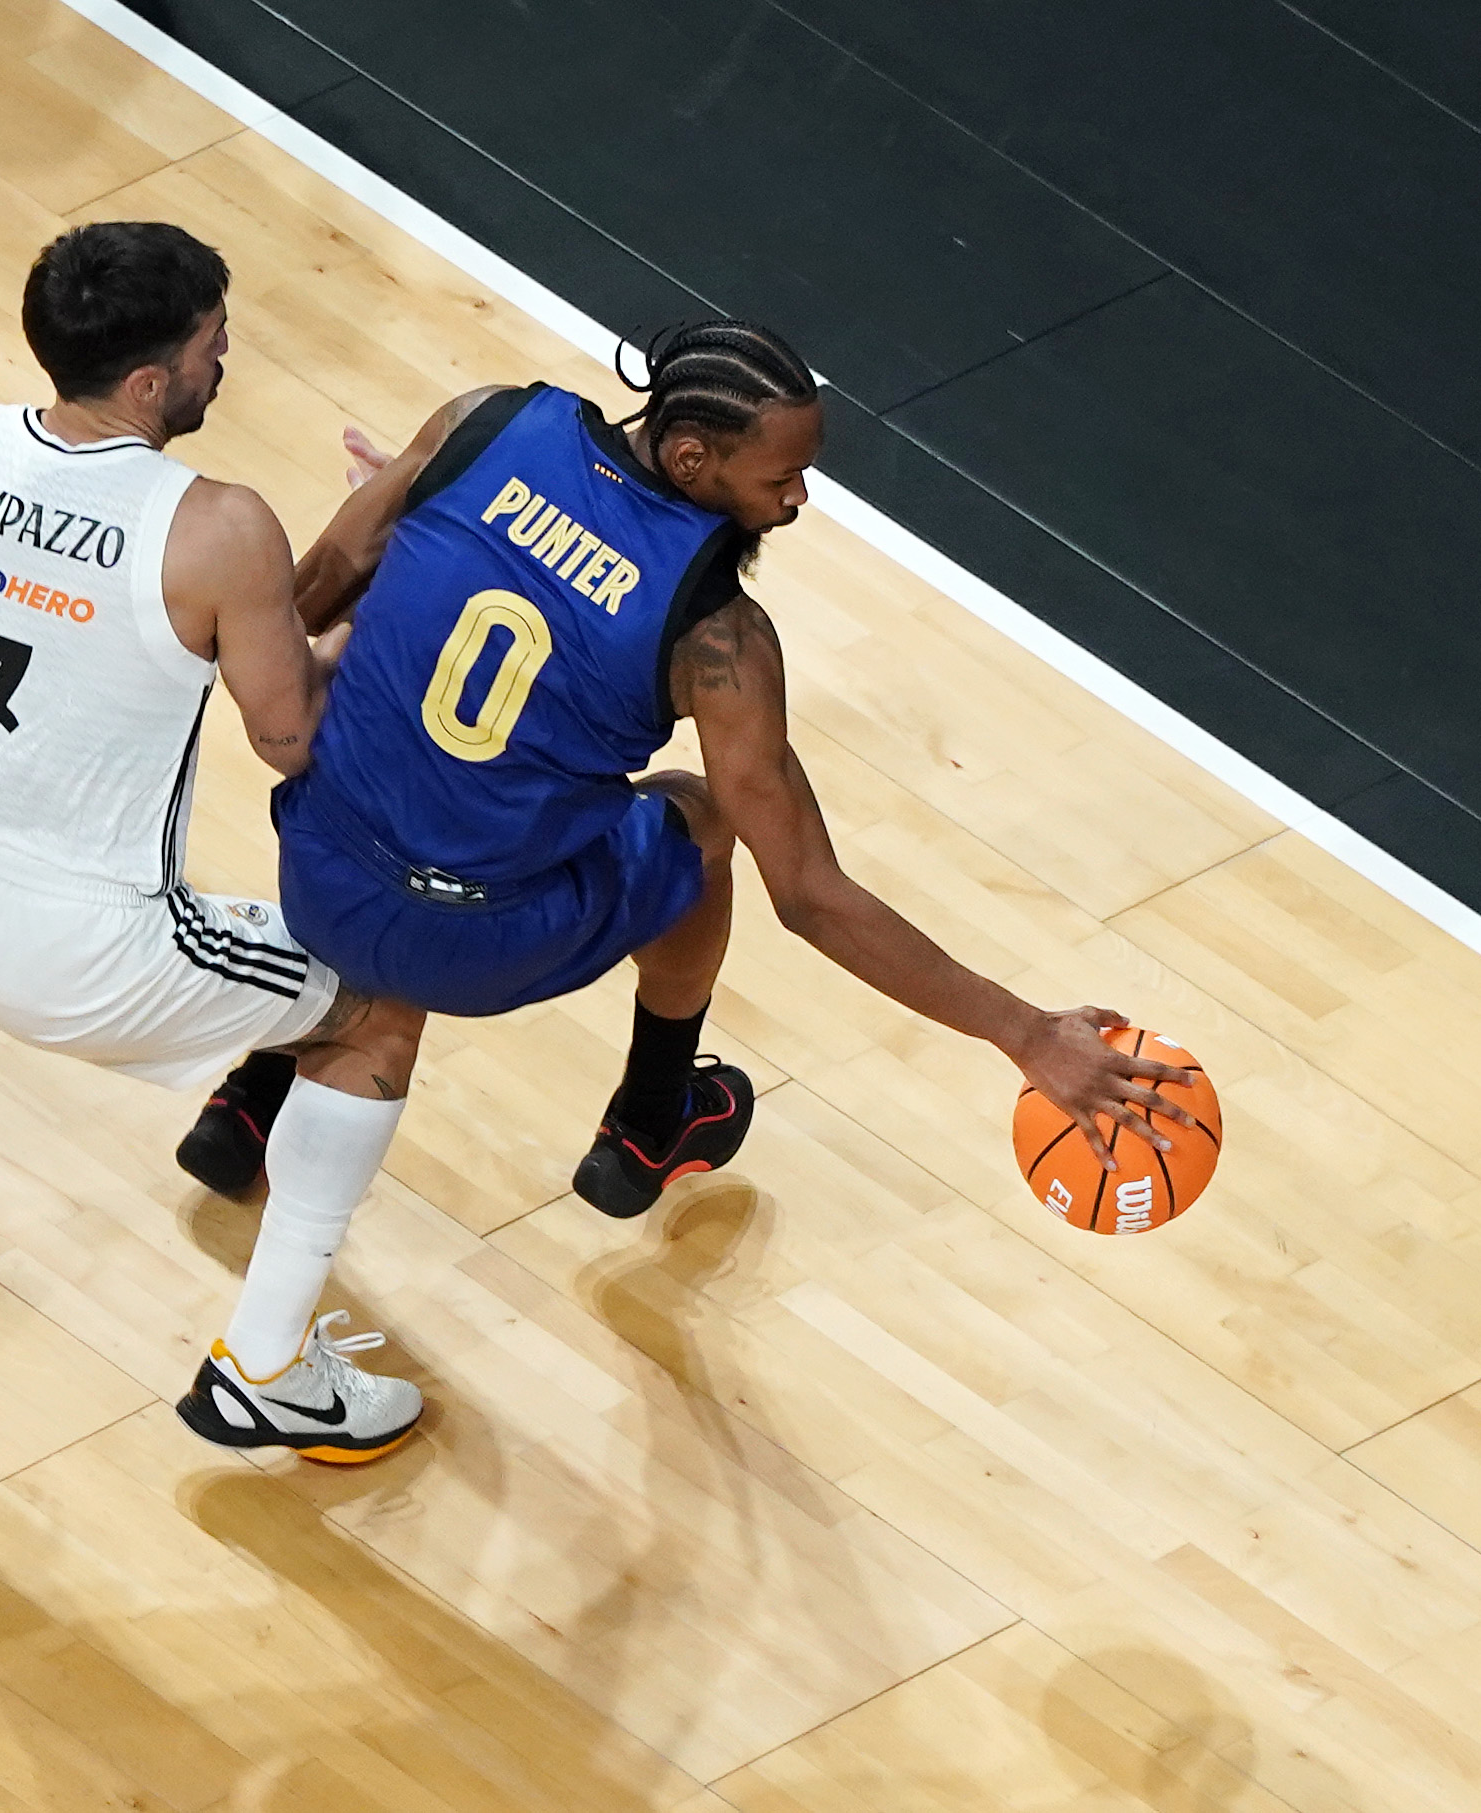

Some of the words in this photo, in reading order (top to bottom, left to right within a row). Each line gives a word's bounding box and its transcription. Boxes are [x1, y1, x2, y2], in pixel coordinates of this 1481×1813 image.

[480, 476, 640, 616] PUNTER
[421, 588, 553, 762] 0
[1114, 1175, 1153, 1234] Wil
